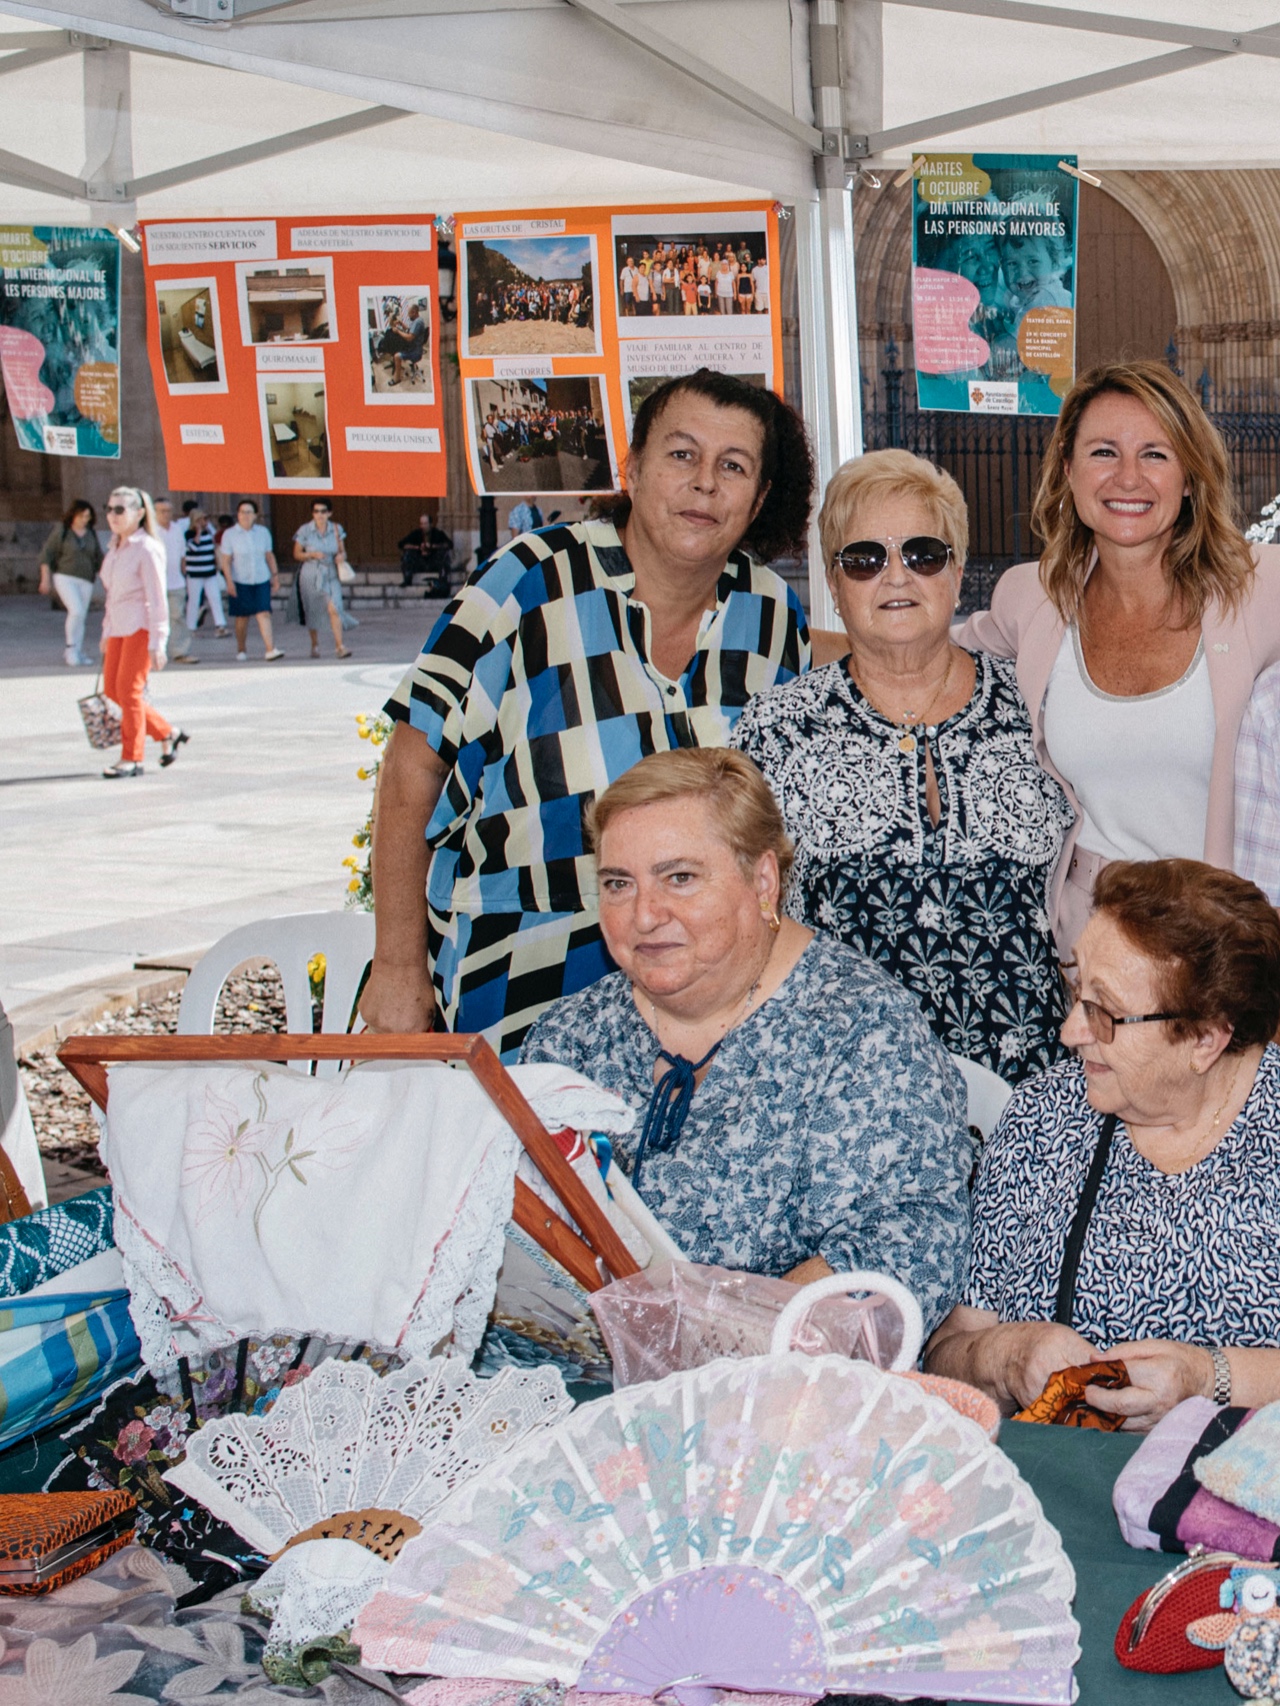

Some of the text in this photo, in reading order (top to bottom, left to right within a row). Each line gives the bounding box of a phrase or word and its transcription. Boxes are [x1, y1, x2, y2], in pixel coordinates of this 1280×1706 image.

[920, 162, 963, 176] MARTES
[920, 182, 980, 196] 1 OCTUBRE
[930, 198, 1060, 217] DÍA INTERNACIONAL DE
[329, 229, 338, 237] DE
[340, 229, 374, 237] NUESTRO
[375, 229, 410, 237] SERVICIO
[411, 229, 421, 237] DE
[464, 220, 563, 235] LAS GRUTAS DE CRISTAL
[925, 220, 1066, 237] LAS PERSONAS MAYORES
[150, 228, 265, 239] NUESTRO CENTRO CUENTA CON
[151, 241, 257, 252] LOS SIGUIENTES SERVICIOS
[298, 239, 313, 247] BAR
[20, 267, 91, 283] INTERNACIONAL
[94, 270, 107, 283] DE
[5, 284, 107, 300] LES PERSONES MAJORS
[626, 342, 763, 352] VIAJE FAMILIAR AL CENTRO DE
[262, 354, 319, 365] QUIROMASAJE
[740, 352, 746, 360] Y
[753, 352, 763, 360] AL
[500, 366, 552, 377] CINCTORRES
[628, 364, 656, 373] MUSEO
[657, 364, 669, 372] DE
[670, 363, 699, 372] BELLAS
[351, 432, 433, 444] PELUQUERÍA UNISEX
